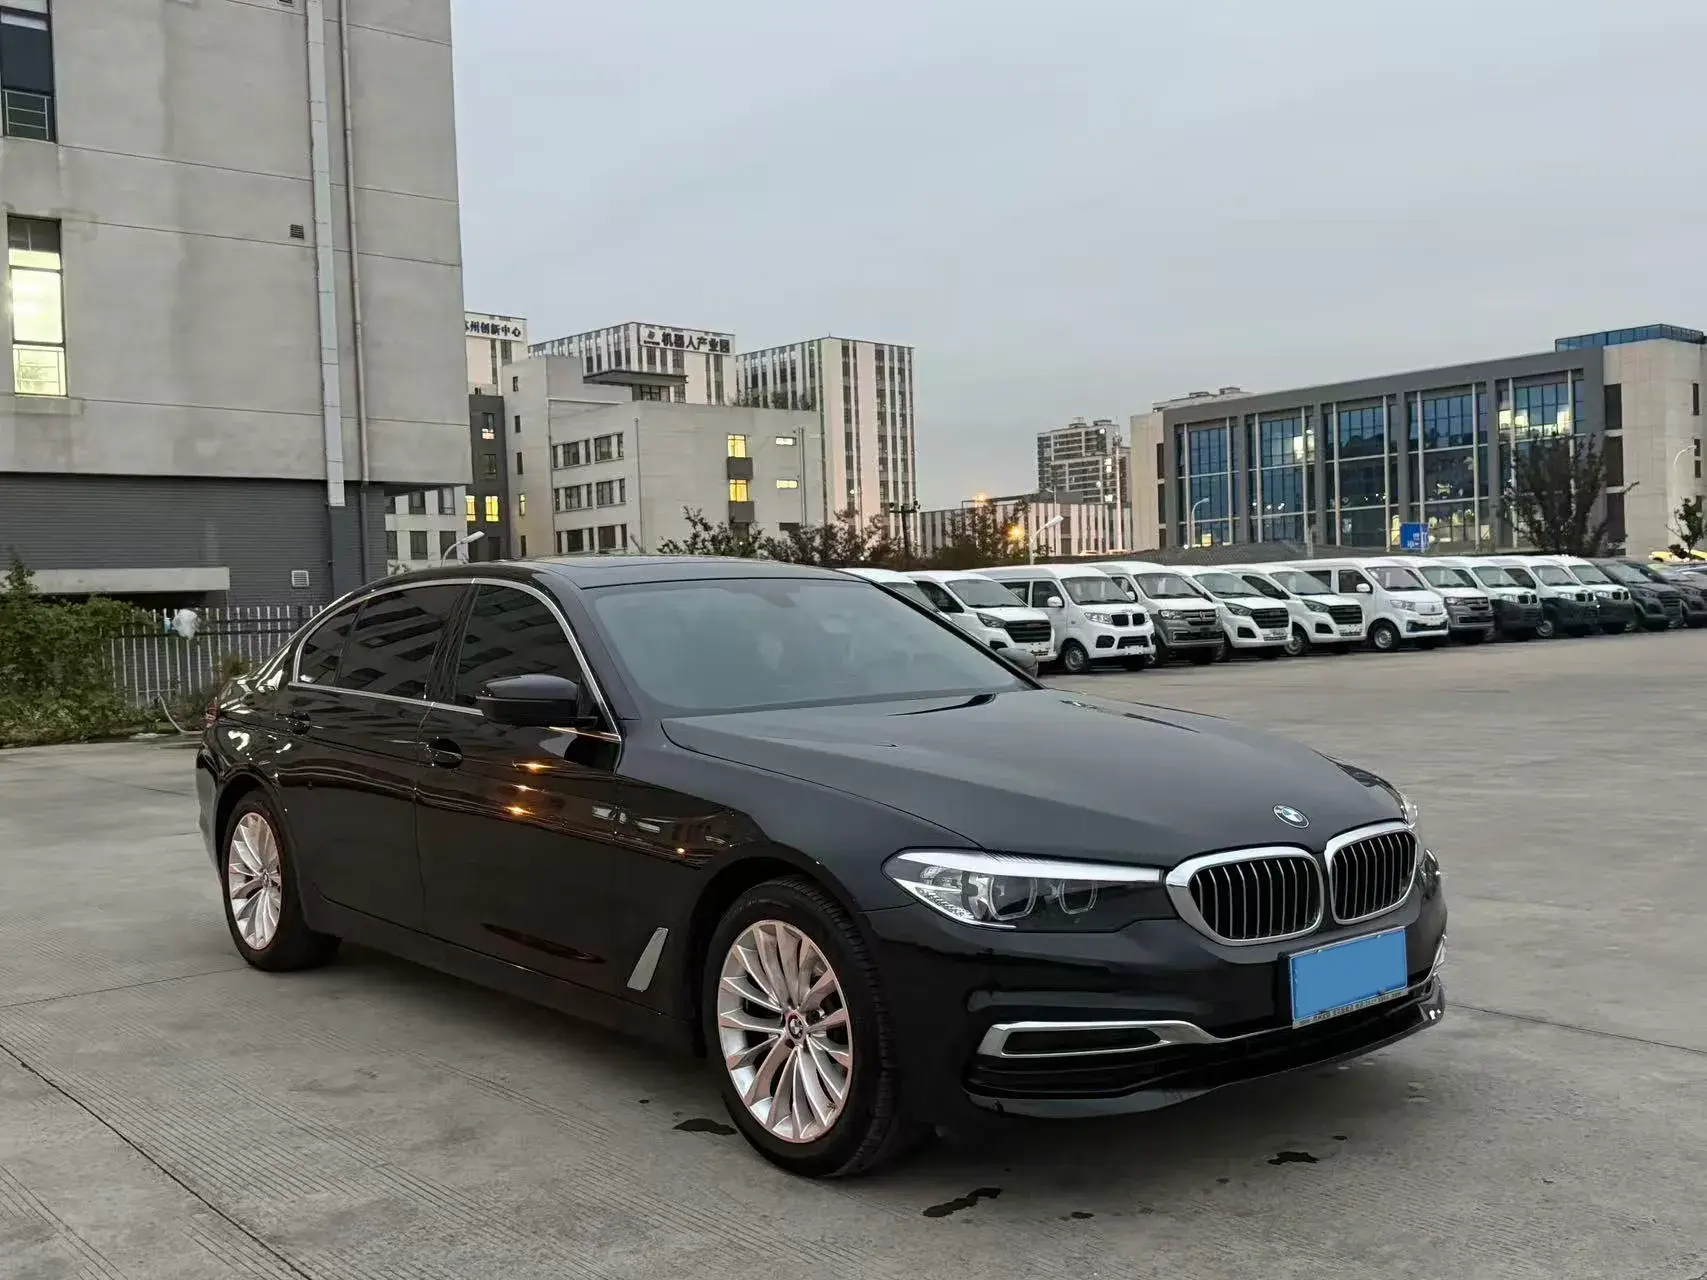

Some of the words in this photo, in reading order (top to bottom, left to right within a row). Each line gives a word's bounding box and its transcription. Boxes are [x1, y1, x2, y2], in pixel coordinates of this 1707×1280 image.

[662, 332, 730, 353] 机器人产业园
